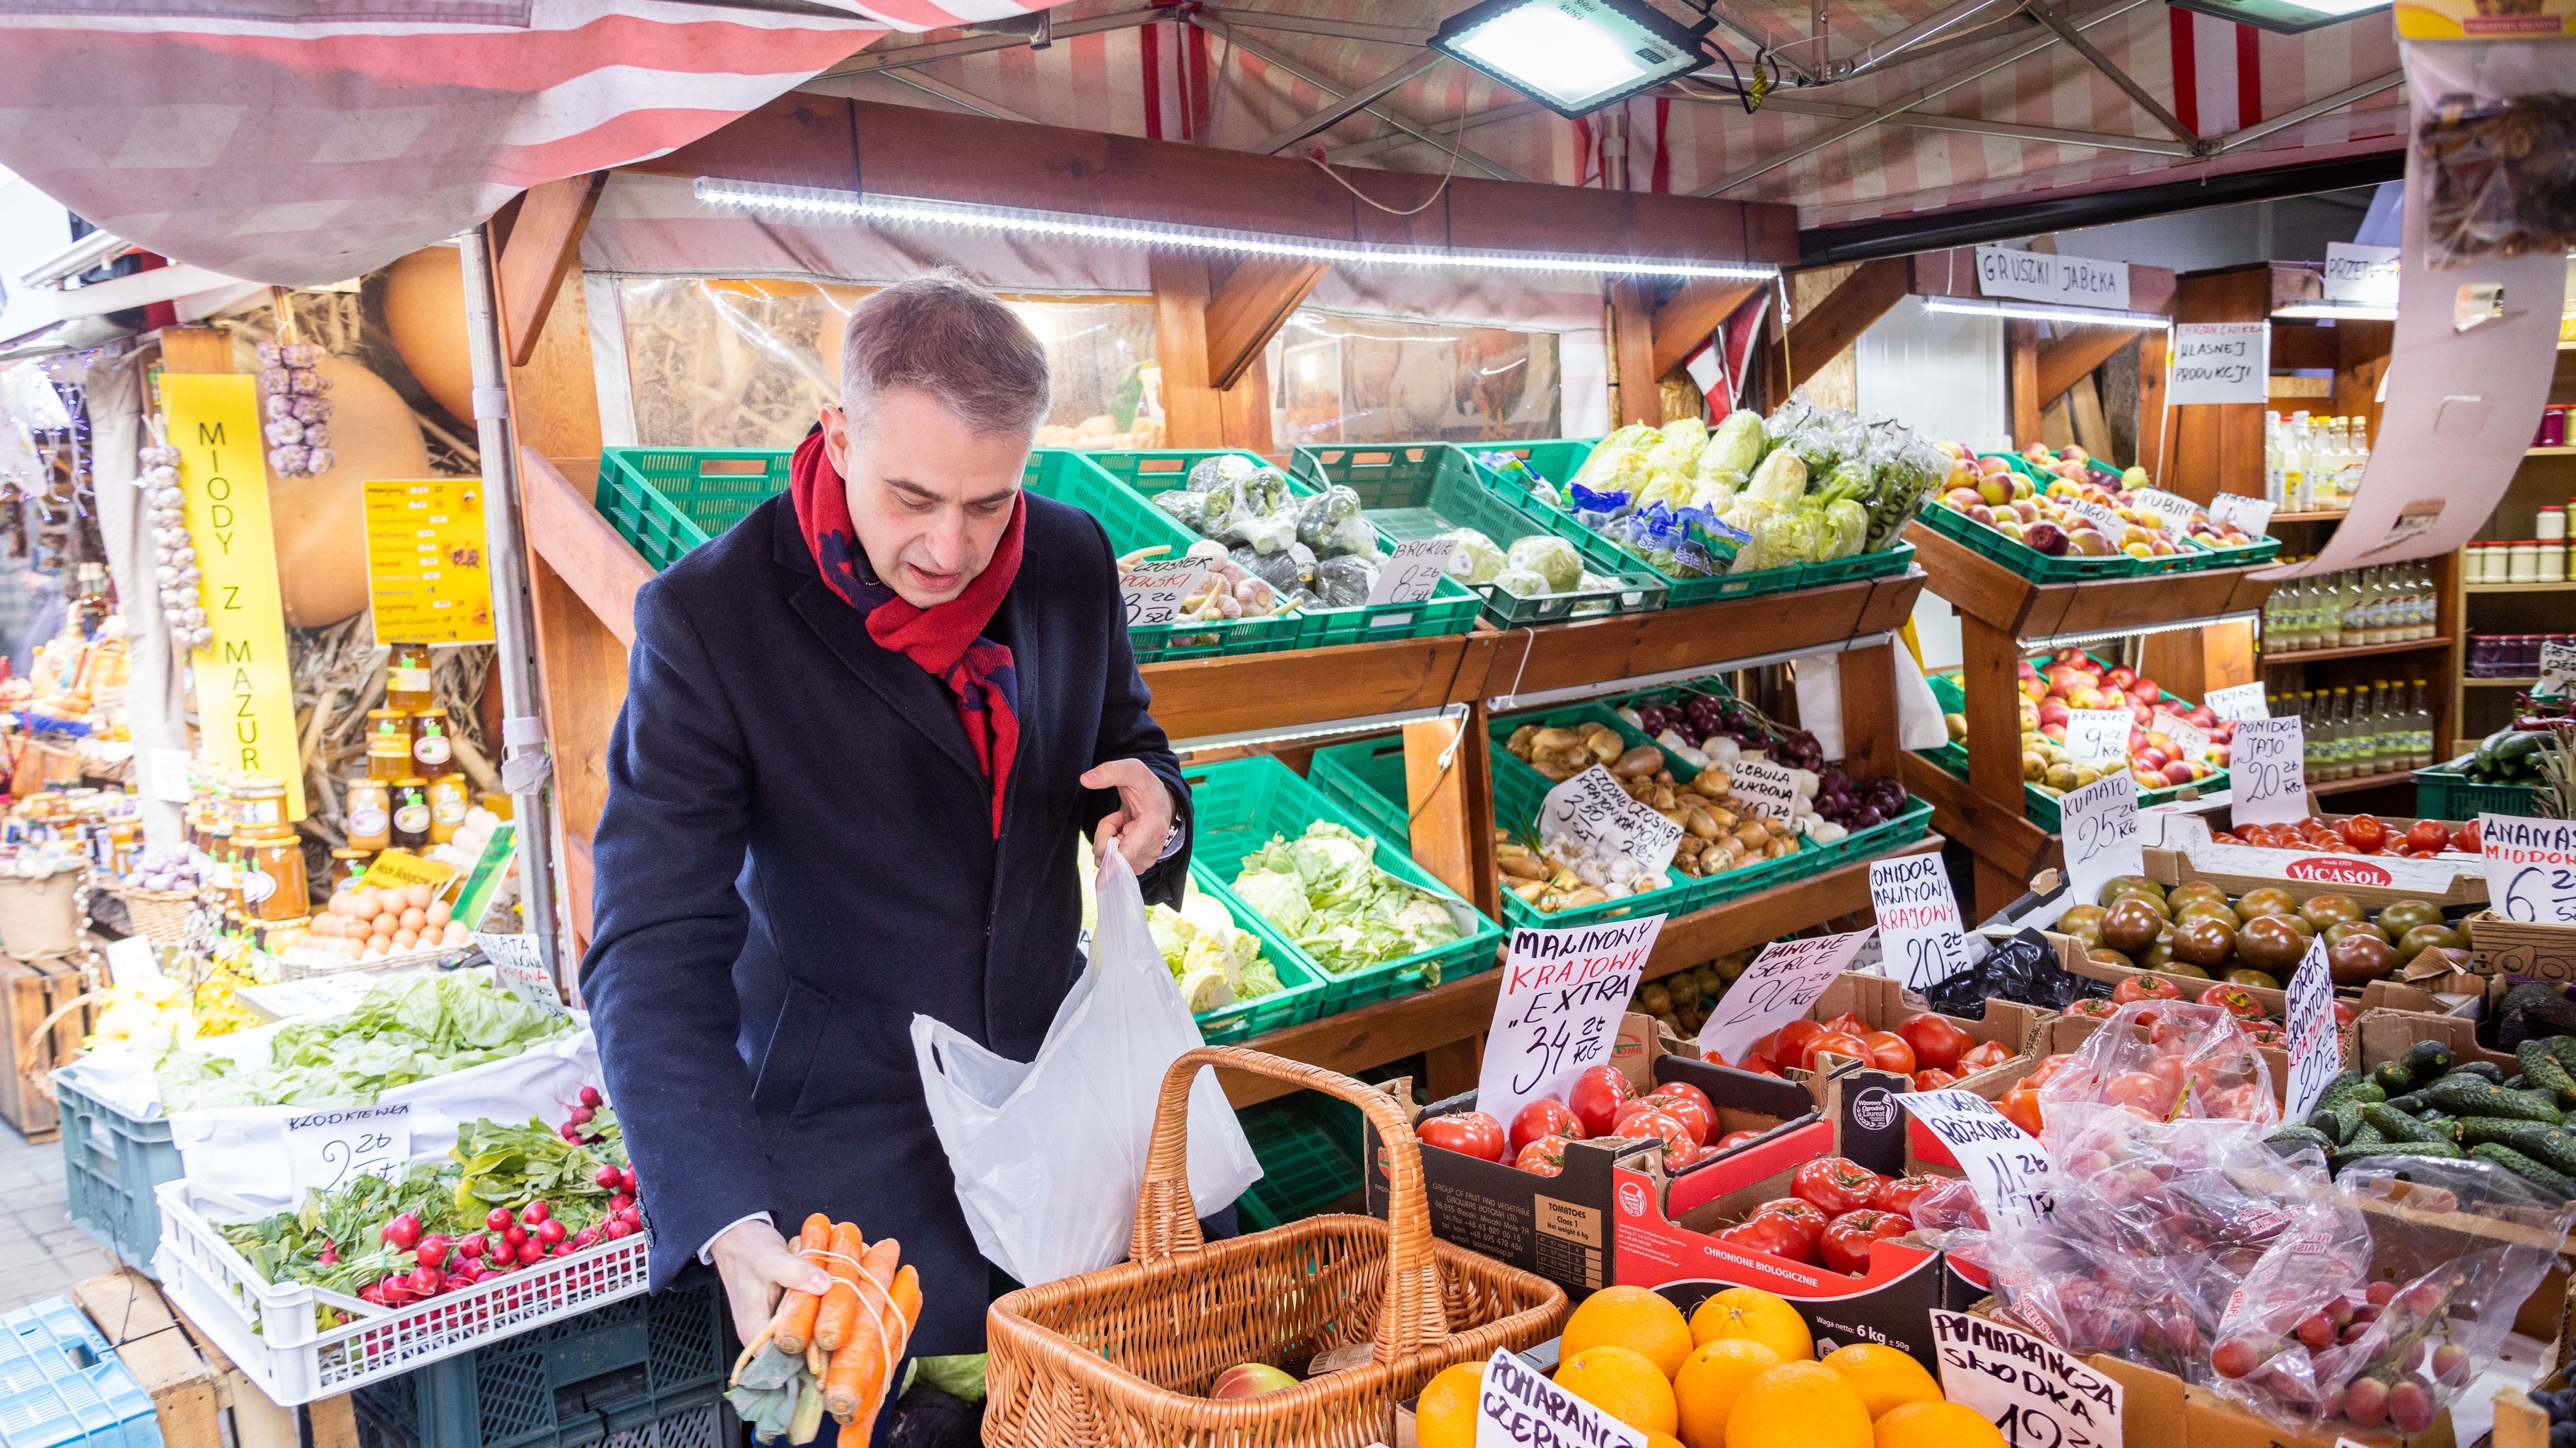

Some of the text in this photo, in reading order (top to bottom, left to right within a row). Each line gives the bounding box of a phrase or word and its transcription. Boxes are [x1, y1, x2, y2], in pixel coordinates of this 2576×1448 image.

[1557, 4, 1585, 20] 150W
[1639, 49, 1663, 63] mini
[1641, 37, 1678, 59] Floodlight
[1984, 255, 2117, 293] GRUSZKI JABŁKA
[199, 422, 234, 555] MIODY
[2138, 489, 2192, 518] RUBIN
[2073, 500, 2116, 527] LIGOL
[1133, 557, 1213, 573] CZOSNEK
[222, 586, 242, 609] Z
[1391, 565, 1419, 604] 8
[2237, 718, 2299, 735] POMIDOR
[2080, 728, 2101, 759] 9
[2246, 761, 2280, 802] 20
[2063, 776, 2129, 820] KUMATO
[1627, 801, 1684, 841] CZOSNEK
[2078, 805, 2121, 865] 25
[1870, 858, 1937, 887] POMIDOR
[2506, 866, 2546, 922] 6
[1879, 898, 1955, 933] KRAJOWY
[1509, 945, 1647, 996] KRAJOWY
[1750, 950, 1839, 979] SERCE
[1907, 938, 1945, 990] 20
[1723, 976, 1805, 1027] 20
[1513, 1020, 1571, 1096] 34
[1374, 1184, 1389, 1193] PROD
[1432, 1182, 1531, 1218] GROUP OF FRUIT AND VEGETABLE
[1434, 1201, 1455, 1213] 98-235
[1521, 1226, 1530, 1236] 7A
[1446, 1195, 1519, 1223] GROWERS BOTOMA LTD.
[1548, 1203, 1586, 1219] TOMATOES
[1557, 1215, 1573, 1226] Class
[1483, 1233, 1495, 1244] 695
[1497, 1238, 1509, 1248] 472
[1511, 1242, 1523, 1252] 486
[1488, 1226, 1500, 1235] 829
[1502, 1230, 1511, 1239] 06
[1513, 1233, 1521, 1242] 18
[1547, 1222, 1557, 1230] Net
[1557, 1226, 1576, 1237] weight
[1581, 1232, 1589, 1240] kg
[1704, 1245, 1819, 1288] CHRONIONE BIOLOGICZNIE
[1816, 1316, 1834, 1328] Waga
[1834, 1322, 1855, 1334] netto:
[1856, 1324, 1866, 1337] 6
[1868, 1326, 1887, 1345] kg
[1895, 1340, 1910, 1352] 50g
